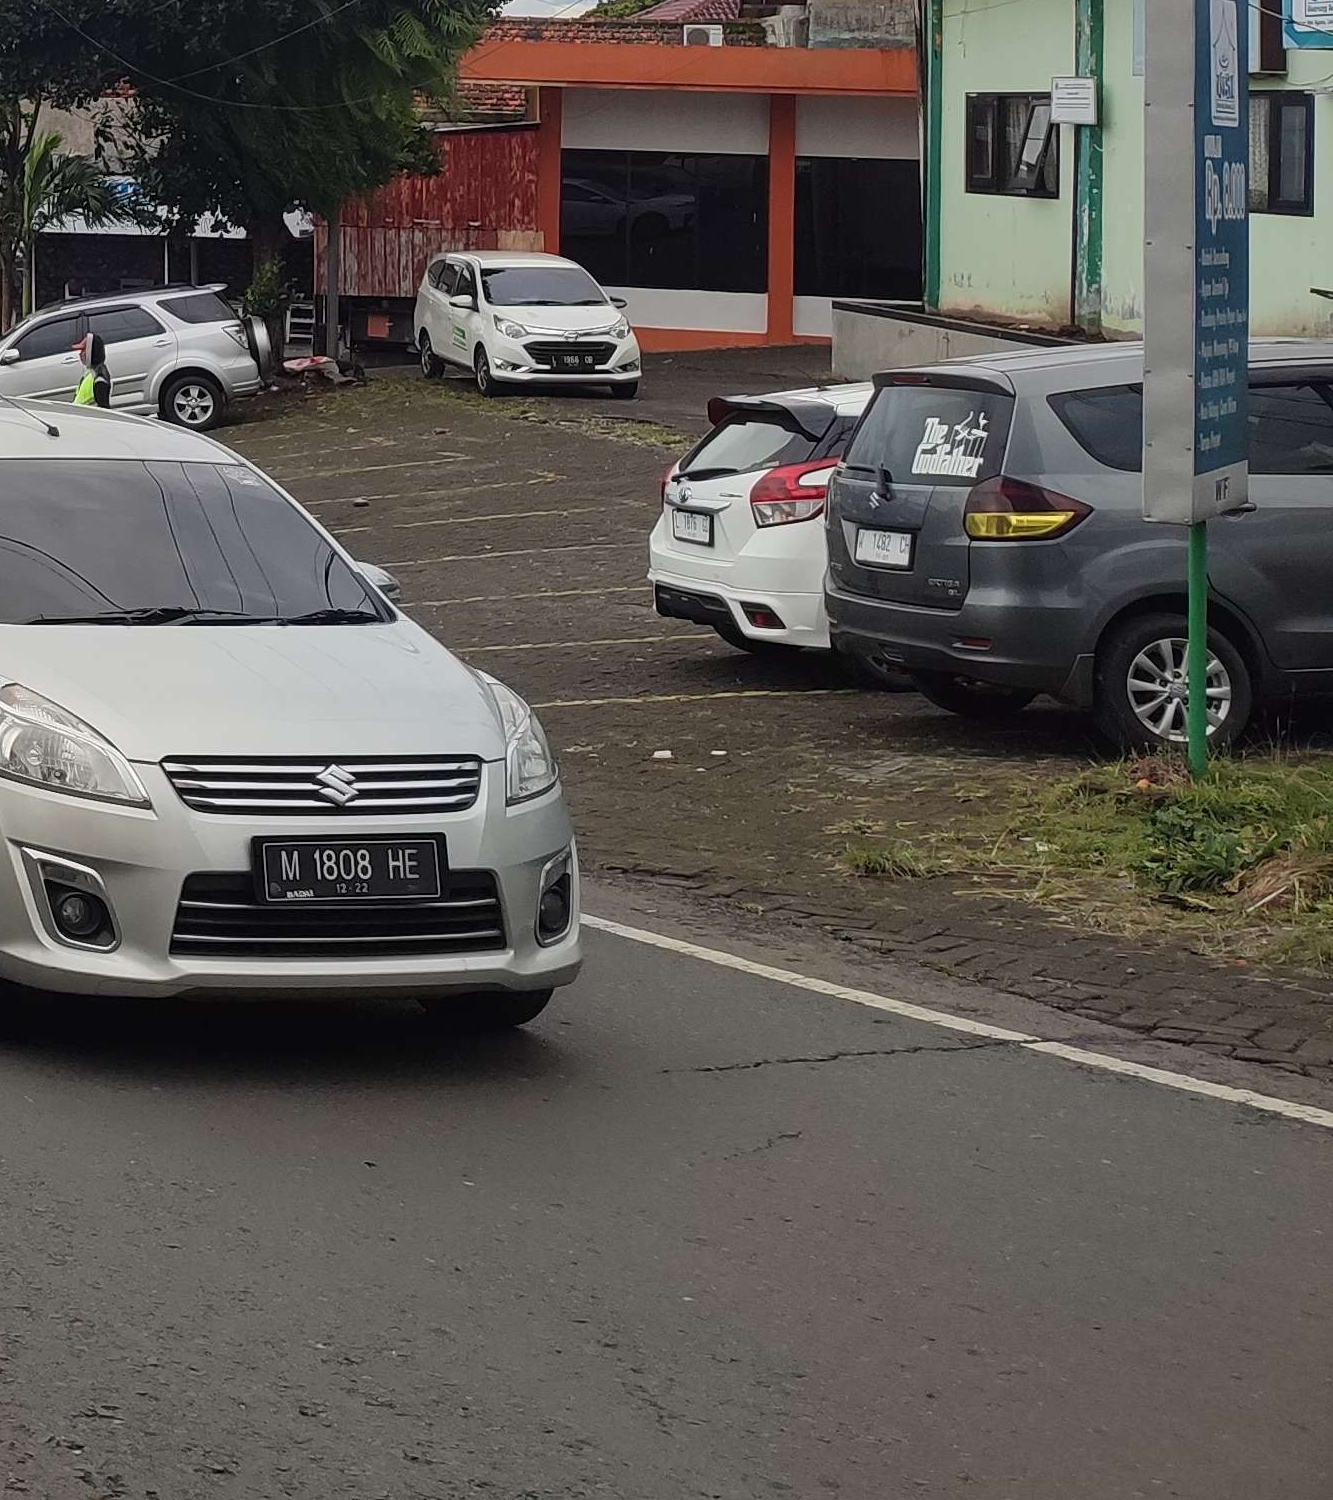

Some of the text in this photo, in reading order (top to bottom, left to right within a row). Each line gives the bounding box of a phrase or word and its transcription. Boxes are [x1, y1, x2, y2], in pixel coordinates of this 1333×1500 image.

[923, 417, 949, 445] The
[911, 442, 984, 478] Godfather
[280, 848, 420, 881] M 1808 HE
